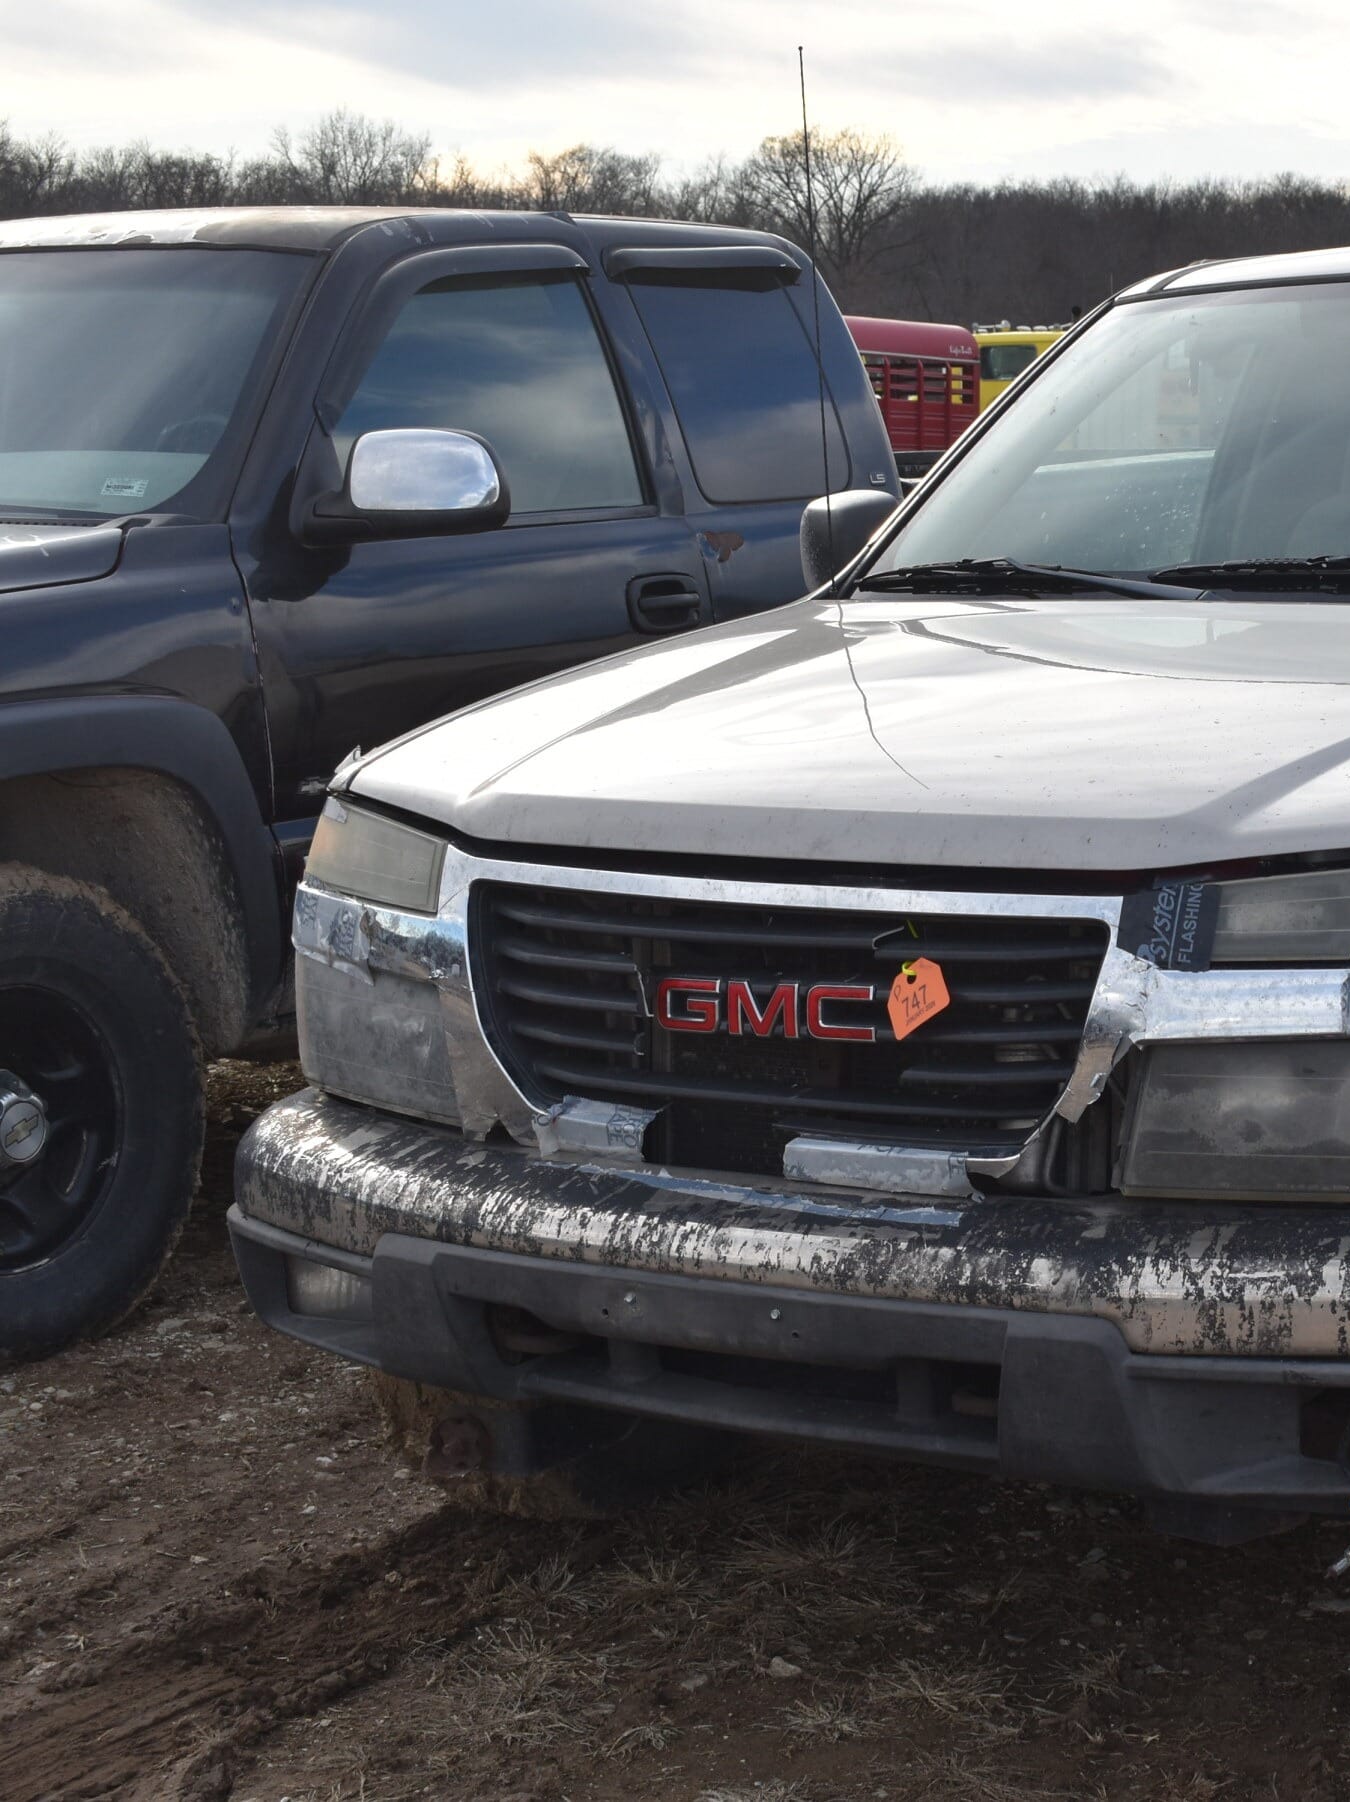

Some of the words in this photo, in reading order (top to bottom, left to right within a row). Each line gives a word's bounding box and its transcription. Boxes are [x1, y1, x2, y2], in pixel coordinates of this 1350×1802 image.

[869, 472, 886, 485] LS
[656, 977, 877, 1042] GMC
[901, 983, 927, 1018] 747
